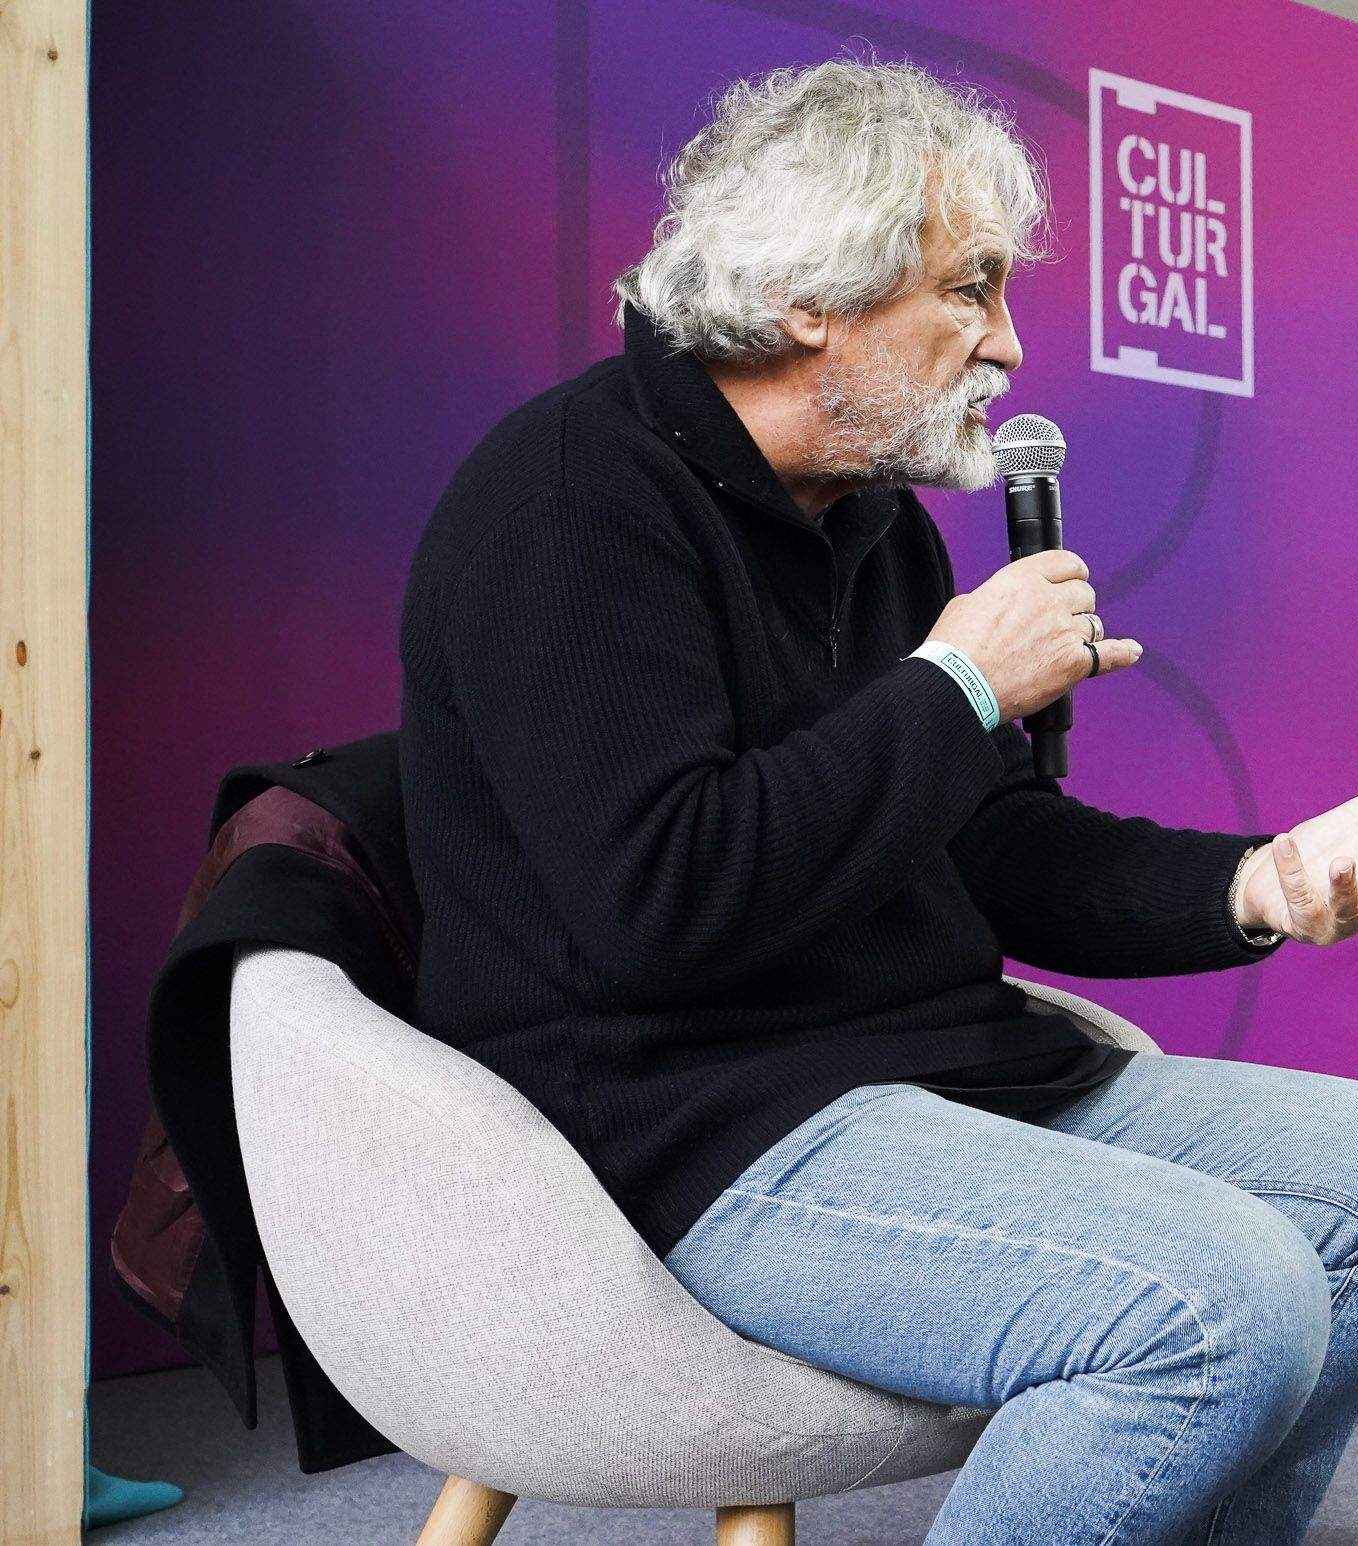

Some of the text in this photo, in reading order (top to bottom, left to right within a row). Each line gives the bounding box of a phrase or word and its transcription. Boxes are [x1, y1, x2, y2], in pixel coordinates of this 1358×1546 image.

[1116, 133, 1227, 214] CUL
[1119, 196, 1229, 278] TUR
[1117, 262, 1227, 339] GAL
